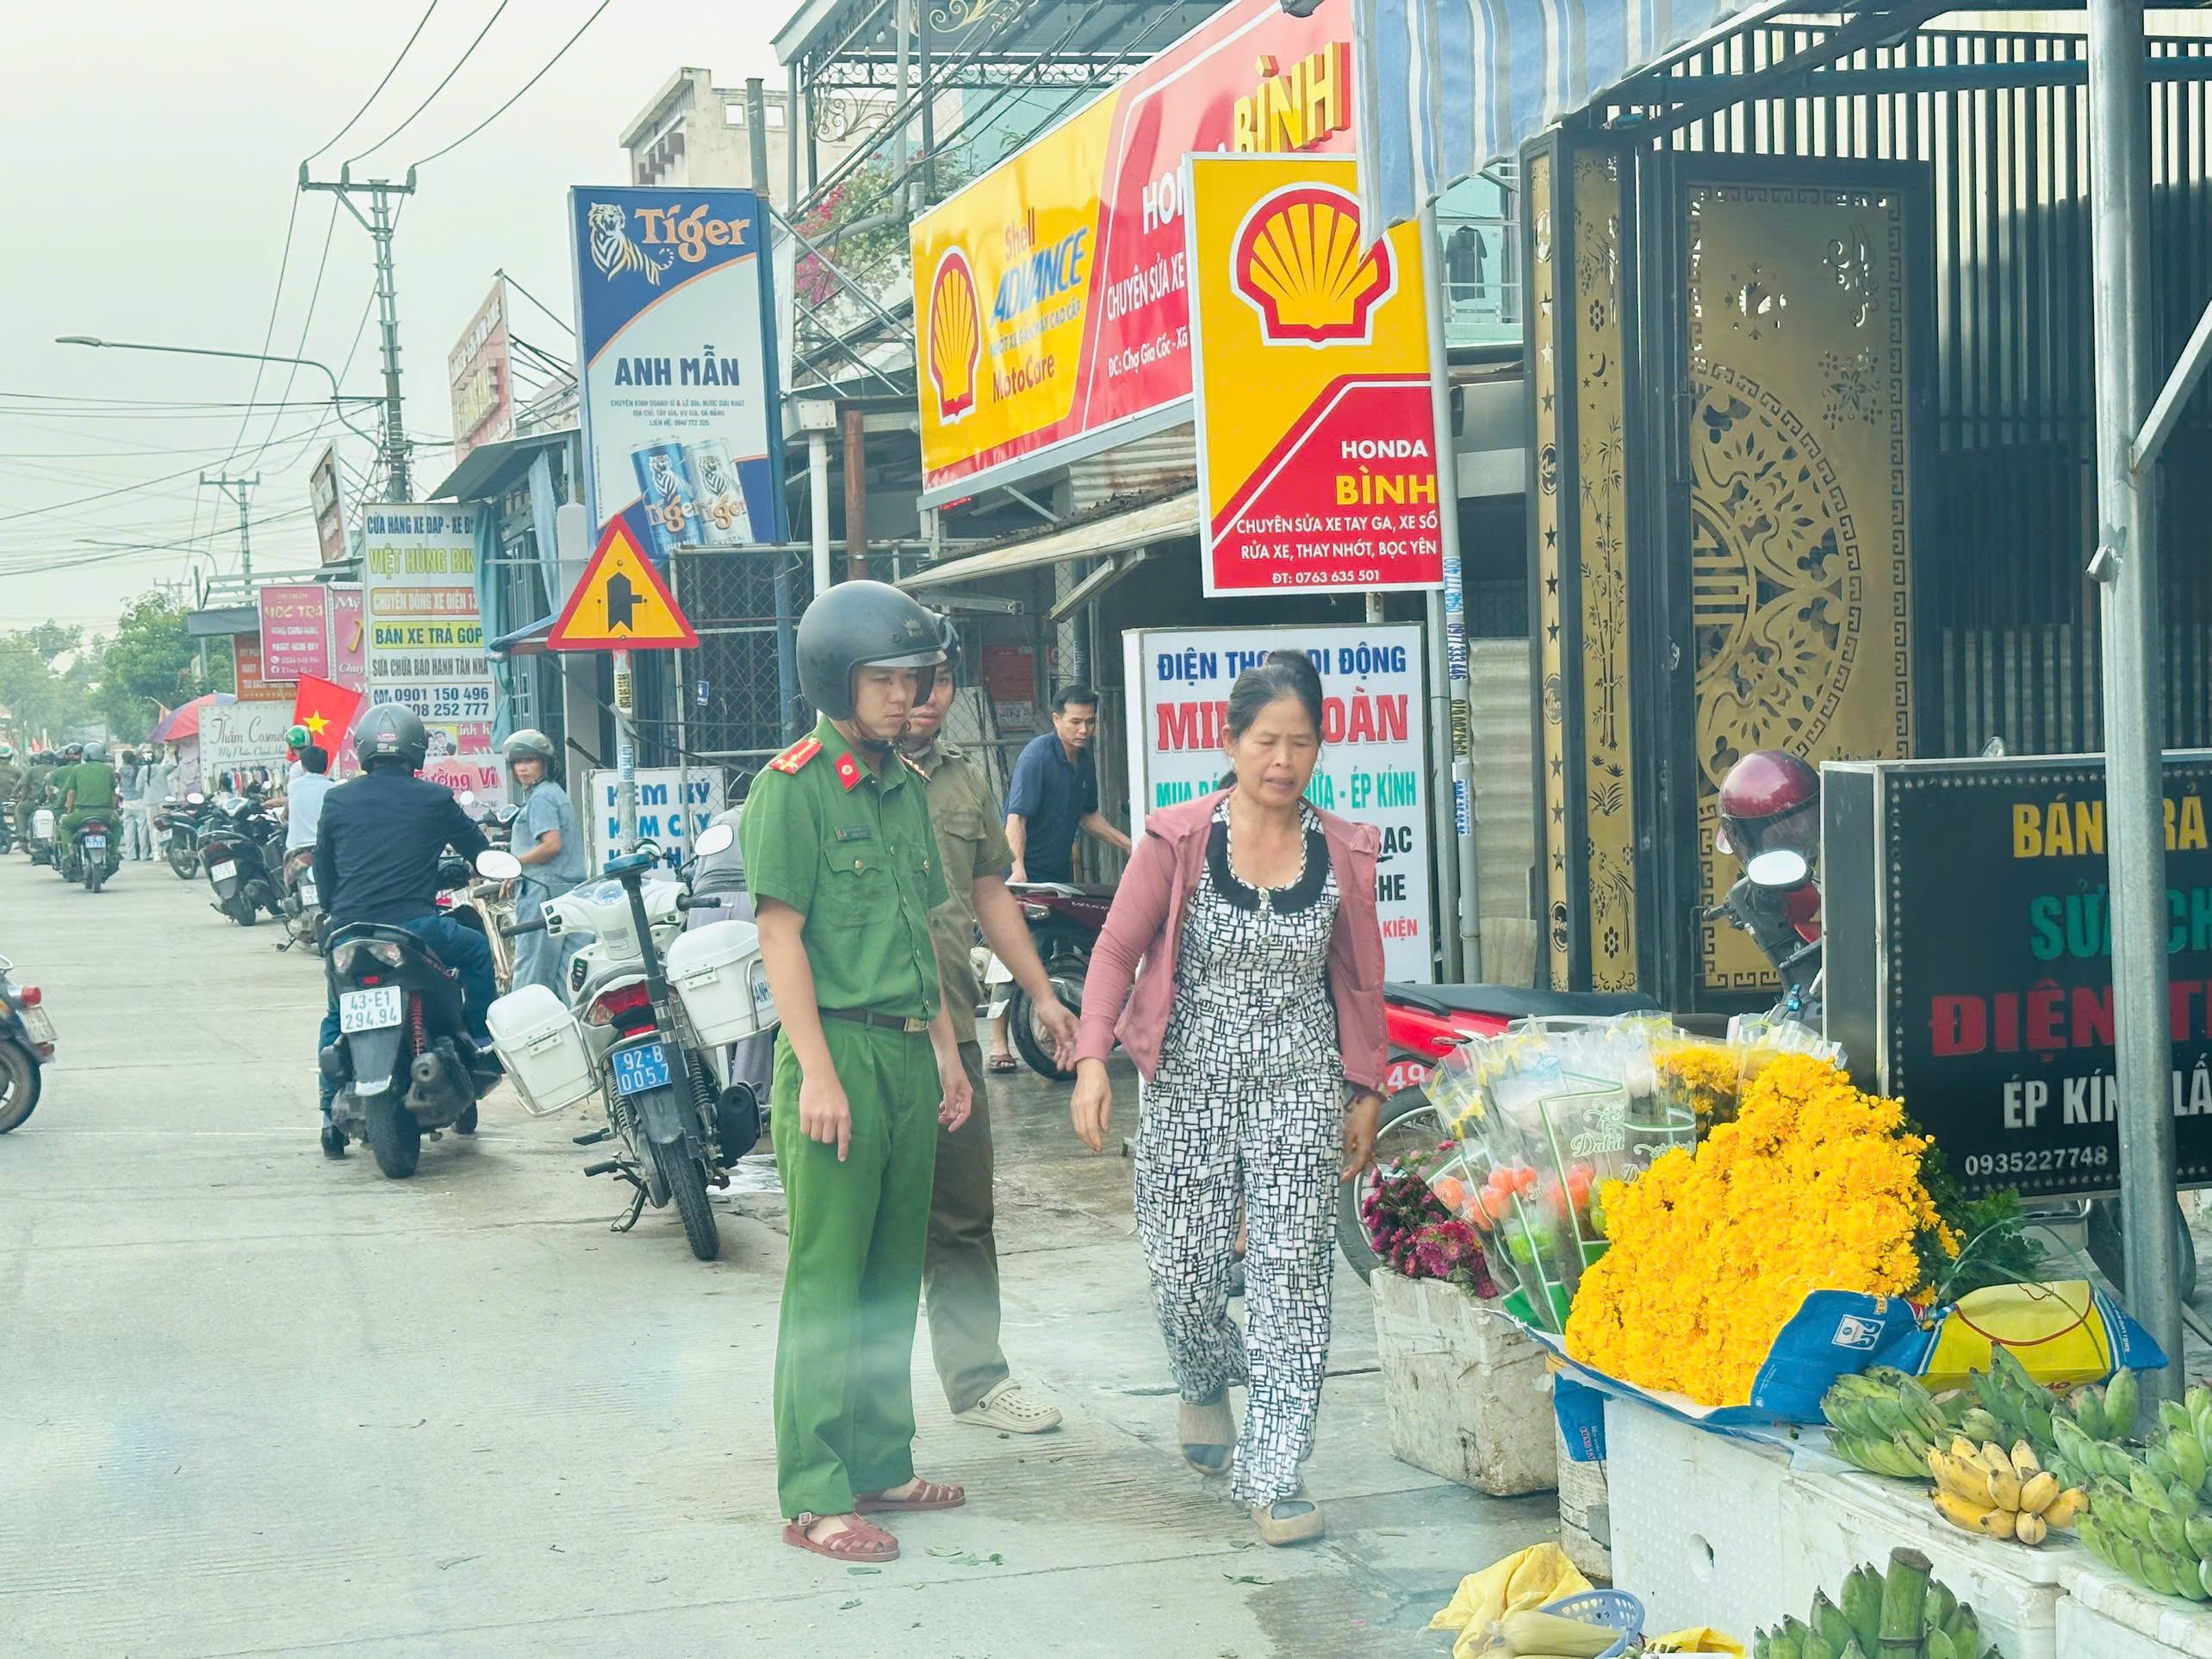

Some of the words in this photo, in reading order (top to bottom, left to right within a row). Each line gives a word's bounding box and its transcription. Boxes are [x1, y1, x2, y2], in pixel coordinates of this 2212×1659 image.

[634, 204, 750, 262] Tiger
[1005, 207, 1035, 261] Shell
[991, 226, 1089, 327] ADVANCE
[1107, 264, 1149, 321] CHUYÊN
[1150, 252, 1170, 302] SỬA
[1171, 252, 1185, 292] XE
[615, 358, 672, 386] ANH
[680, 345, 739, 386] MẪN
[993, 354, 1054, 404] MotoCare
[1341, 439, 1428, 459] HONDA
[1336, 465, 1436, 506] BÌNH
[413, 517, 424, 534] XE
[451, 517, 463, 534] XE
[1236, 515, 1292, 534] CHUYÊN
[1295, 513, 1322, 532] SỬA
[1325, 517, 1341, 531] XE
[1344, 516, 1368, 531] TAY
[1371, 516, 1396, 533] GA,
[1399, 516, 1415, 530] XE
[1420, 510, 1438, 529] SỐ
[369, 543, 401, 580] VIỆT
[405, 543, 447, 574] HÙNG
[1241, 540, 1269, 559] RỬA
[1273, 544, 1293, 562] XE,
[1296, 543, 1330, 558] THAY
[1333, 538, 1375, 559] NHỚT,
[1379, 542, 1407, 559] BỌC
[1411, 537, 1437, 555] YÊN
[1272, 572, 1292, 584] ĐT:
[1296, 571, 1327, 584] 0763
[1331, 571, 1355, 582] 635
[1358, 570, 1379, 581] 501
[376, 625, 402, 643] BÁN
[407, 628, 424, 643] XE
[427, 623, 453, 643] TRẢ
[457, 624, 482, 643] GÓP
[1158, 647, 1217, 686] ĐIỆN
[1339, 641, 1407, 680] ĐỘNG
[395, 688, 427, 701] 0901
[434, 688, 459, 700] 150
[464, 687, 488, 700] 496
[434, 704, 459, 716] 252
[464, 703, 488, 716] 777
[1322, 686, 1409, 747] OÀN
[1351, 766, 1371, 809] ÉP
[1376, 764, 1417, 808] KÍNH
[608, 815, 660, 838] KM
[2012, 792, 2104, 859] BÁN
[1382, 916, 1418, 941] KIỆN
[2029, 878, 2110, 960] SỬ
[345, 1007, 397, 1030] 294.94
[1928, 979, 2115, 1061] ĐIỆN
[623, 1045, 664, 1070] 92-B
[621, 1063, 669, 1090] 005.7
[2003, 1073, 2049, 1128] ÉP
[1965, 1146, 2109, 1176] 0935227748
